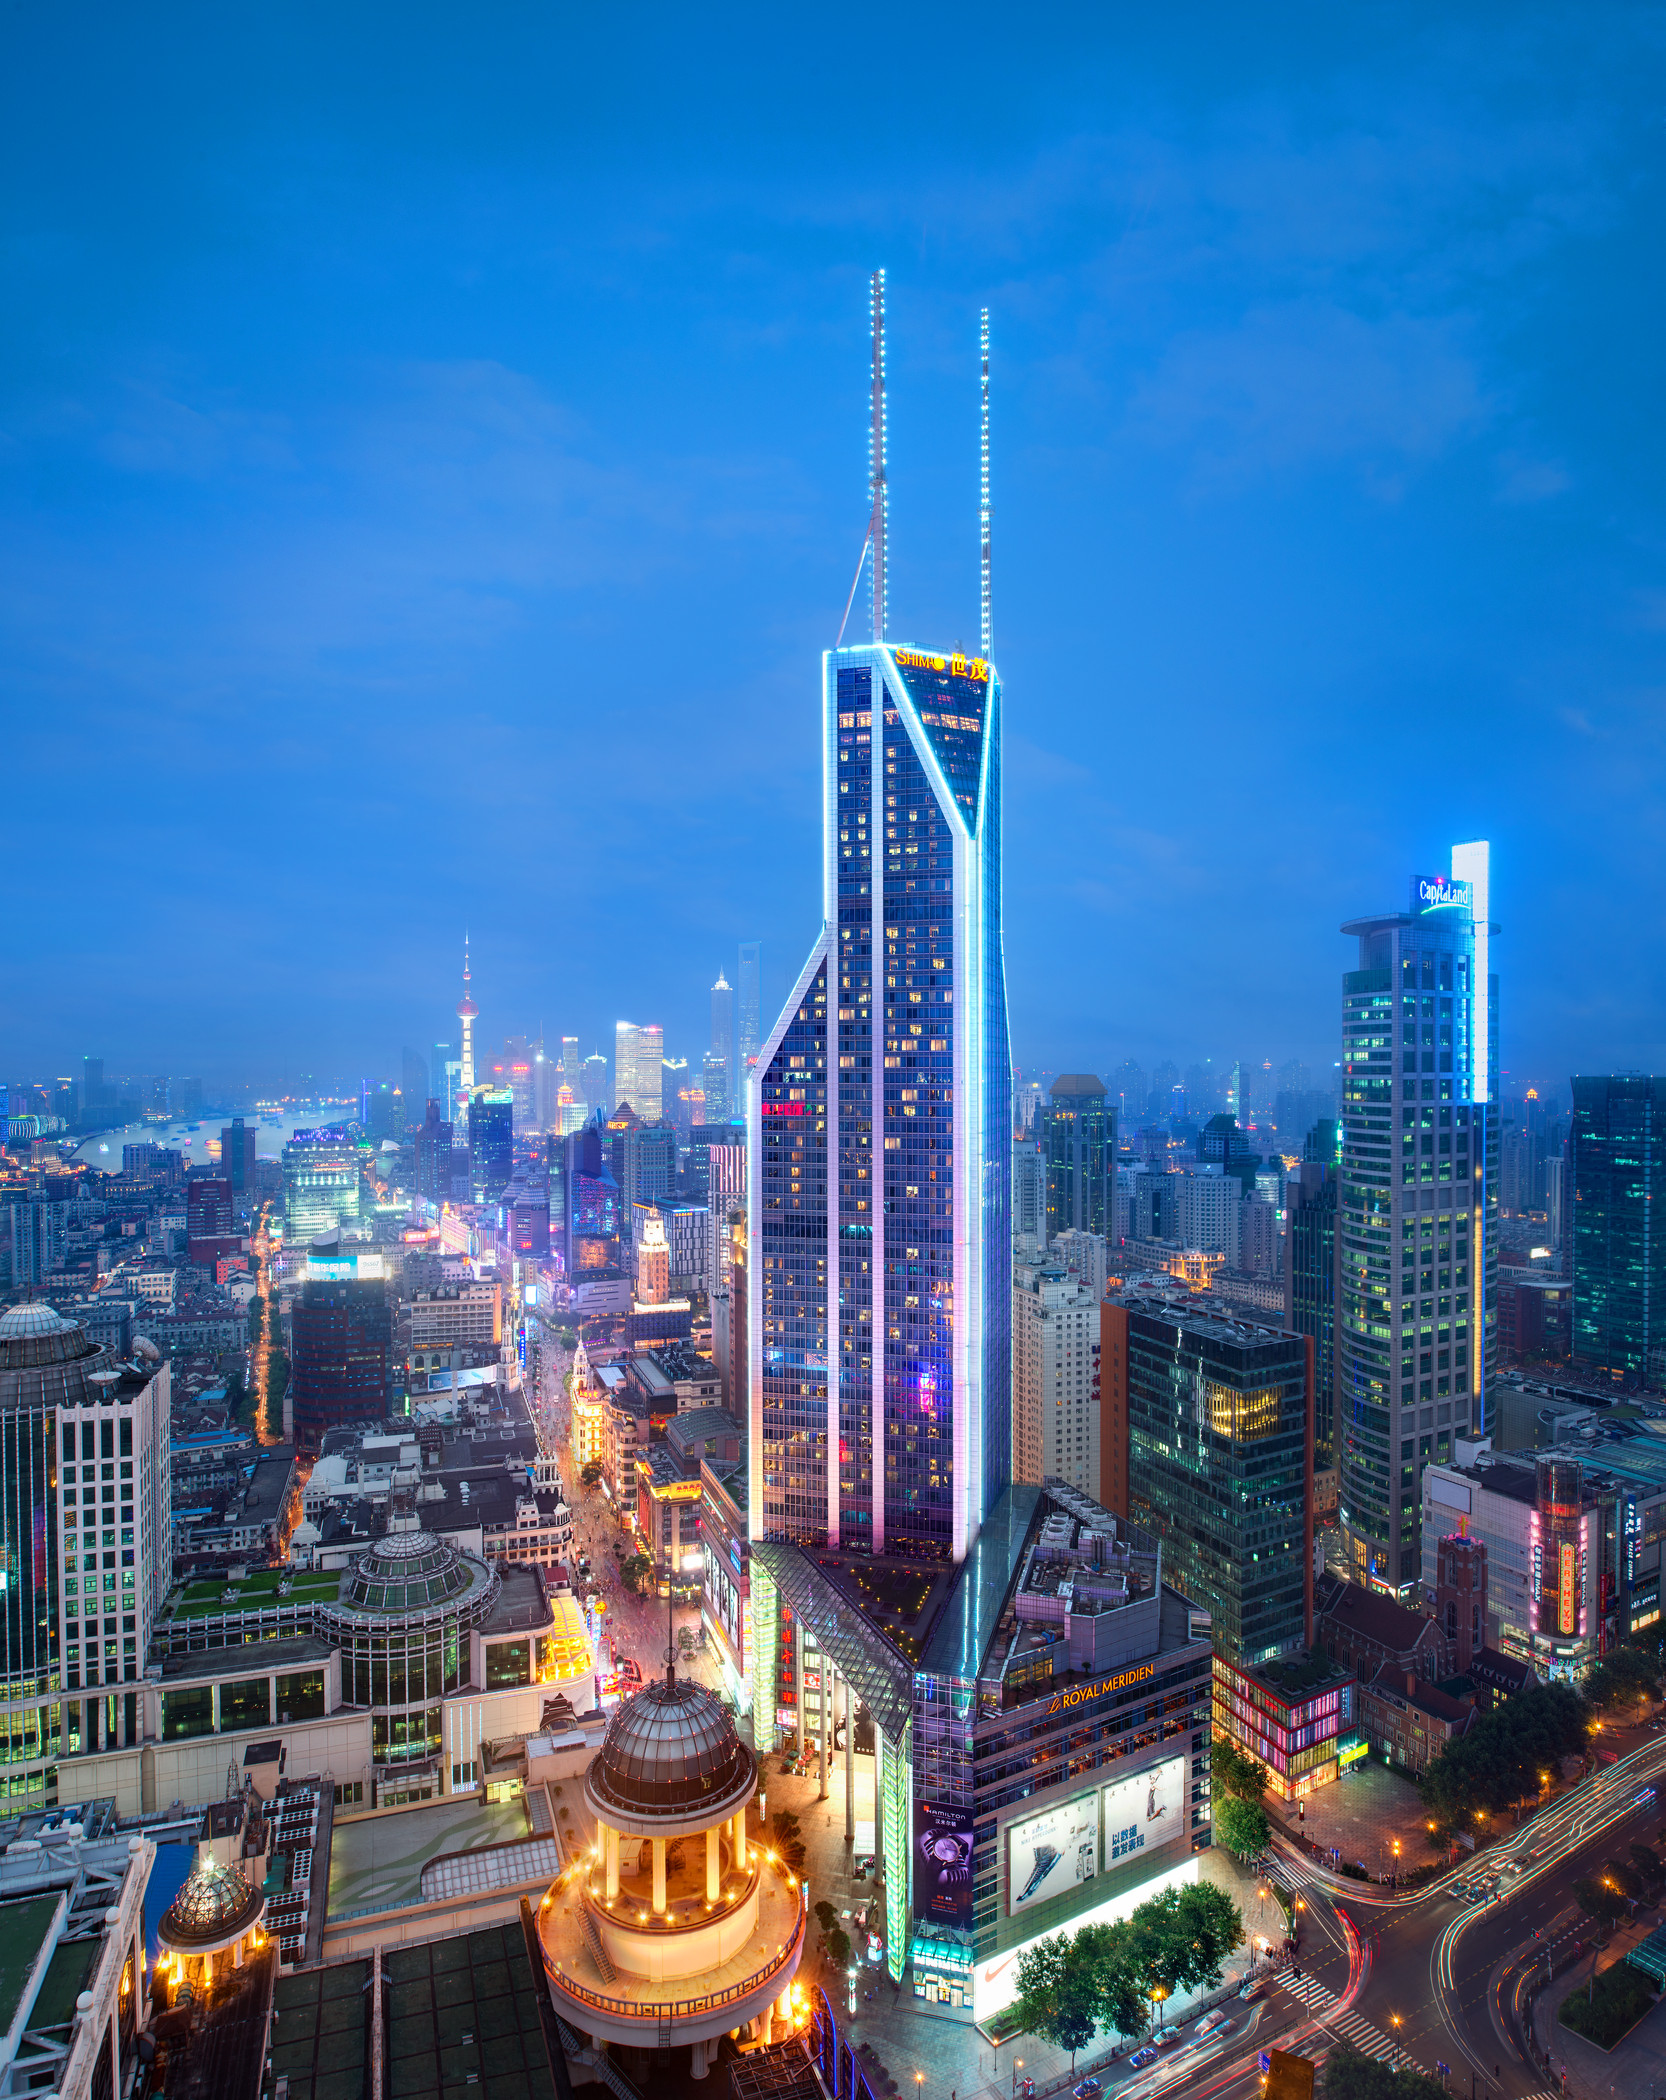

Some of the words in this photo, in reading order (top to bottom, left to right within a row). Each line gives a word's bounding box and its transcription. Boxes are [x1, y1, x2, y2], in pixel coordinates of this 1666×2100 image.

[951, 652, 989, 682] 世茂
[1420, 880, 1468, 905] CapitaLand
[1563, 1549, 1571, 1628] HERSHEY'S
[1063, 1684, 1100, 1708] ROYAL
[1102, 1663, 1154, 1694] MERIDIEN
[926, 1809, 966, 1820] HAMILTON
[1111, 1823, 1137, 1847] 以数据
